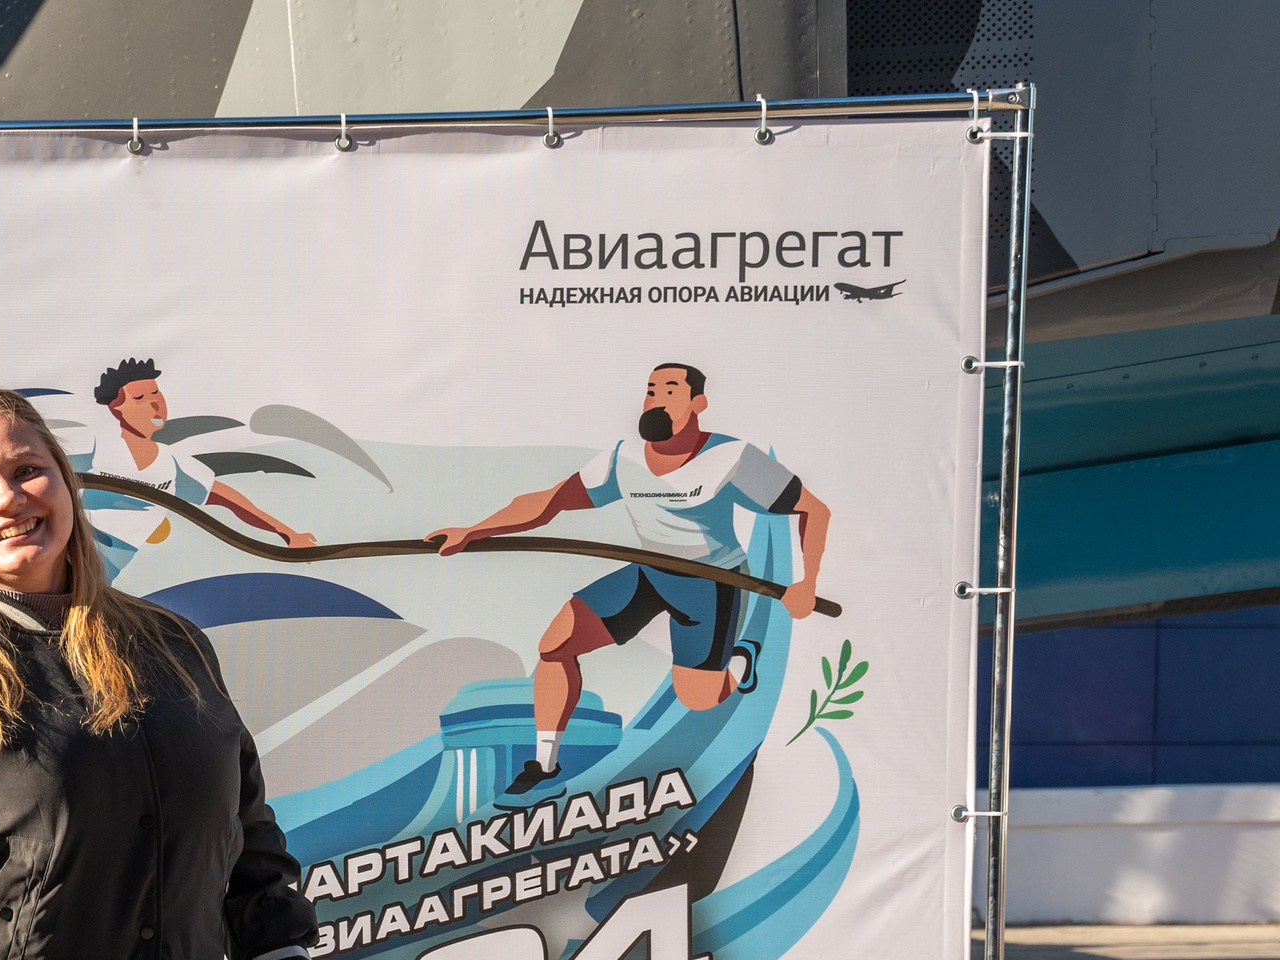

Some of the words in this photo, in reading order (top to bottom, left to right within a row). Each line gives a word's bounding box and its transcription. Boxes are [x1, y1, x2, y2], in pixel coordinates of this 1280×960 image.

[519, 219, 904, 283] Авиаагрегат
[519, 286, 642, 308] НАДЕЖНАЯ
[648, 285, 720, 304] ОПОРА
[724, 284, 830, 306] АВИАЦИИ
[287, 769, 696, 904] АРТАКИАДА
[306, 831, 700, 960] ВИААГРЕГАТА»
